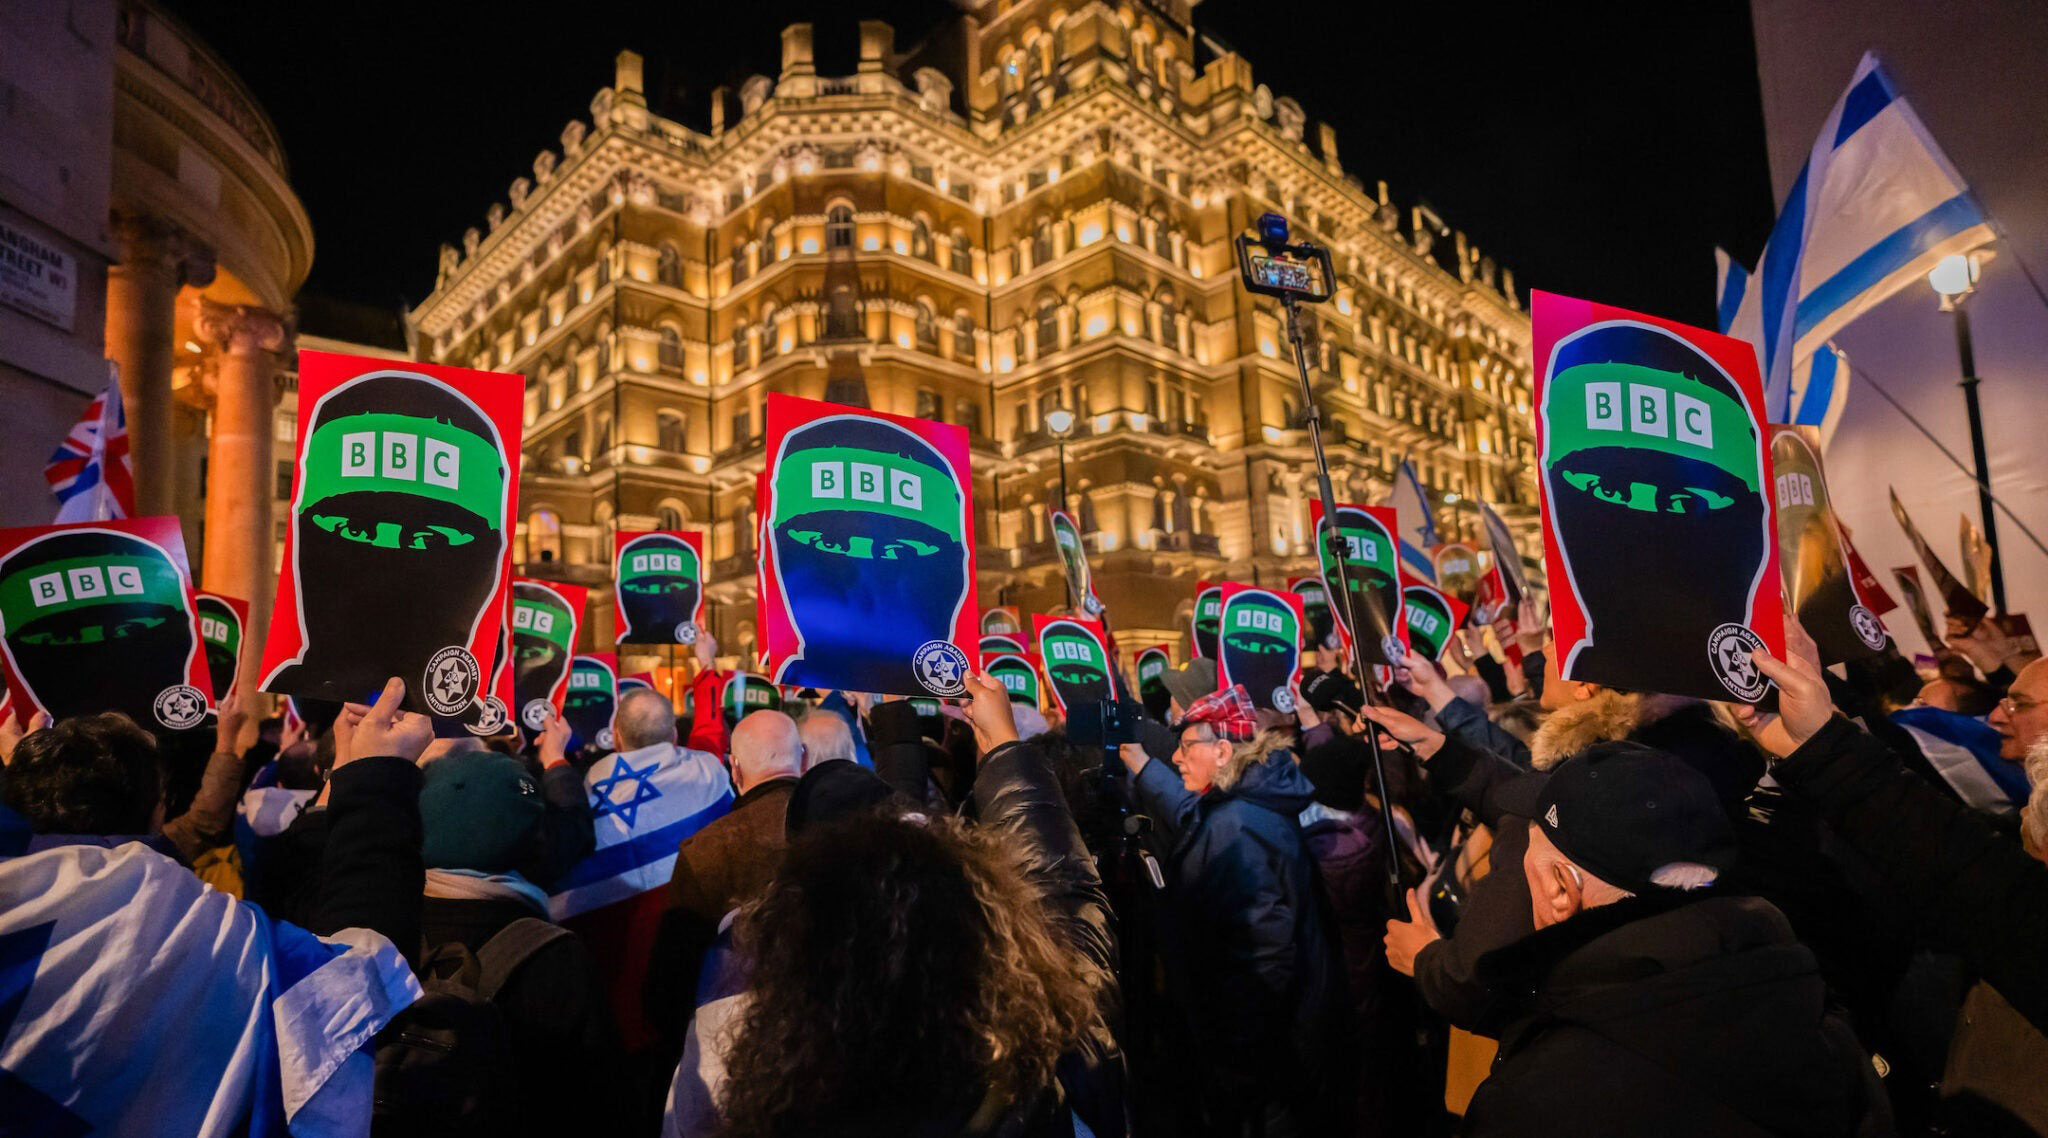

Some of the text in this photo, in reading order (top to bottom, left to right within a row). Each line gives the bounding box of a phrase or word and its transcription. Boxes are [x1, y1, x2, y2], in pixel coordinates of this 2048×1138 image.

[1594, 390, 1705, 438] BBC
[349, 440, 452, 480] BBC
[819, 467, 916, 503] BBC
[636, 557, 679, 570] BBC
[39, 571, 136, 600] BBC
[204, 620, 226, 638] BC
[517, 608, 550, 630] BC
[1240, 613, 1279, 629] BBC
[1711, 627, 1762, 654] CAMPAIGN AGAI
[429, 649, 478, 681] CAMPAIGN AGAINST
[915, 643, 968, 669] CAMPAIGN AGAINST
[1723, 676, 1765, 698] ANTISEMITISM
[427, 693, 468, 713] ANTISEMITISM
